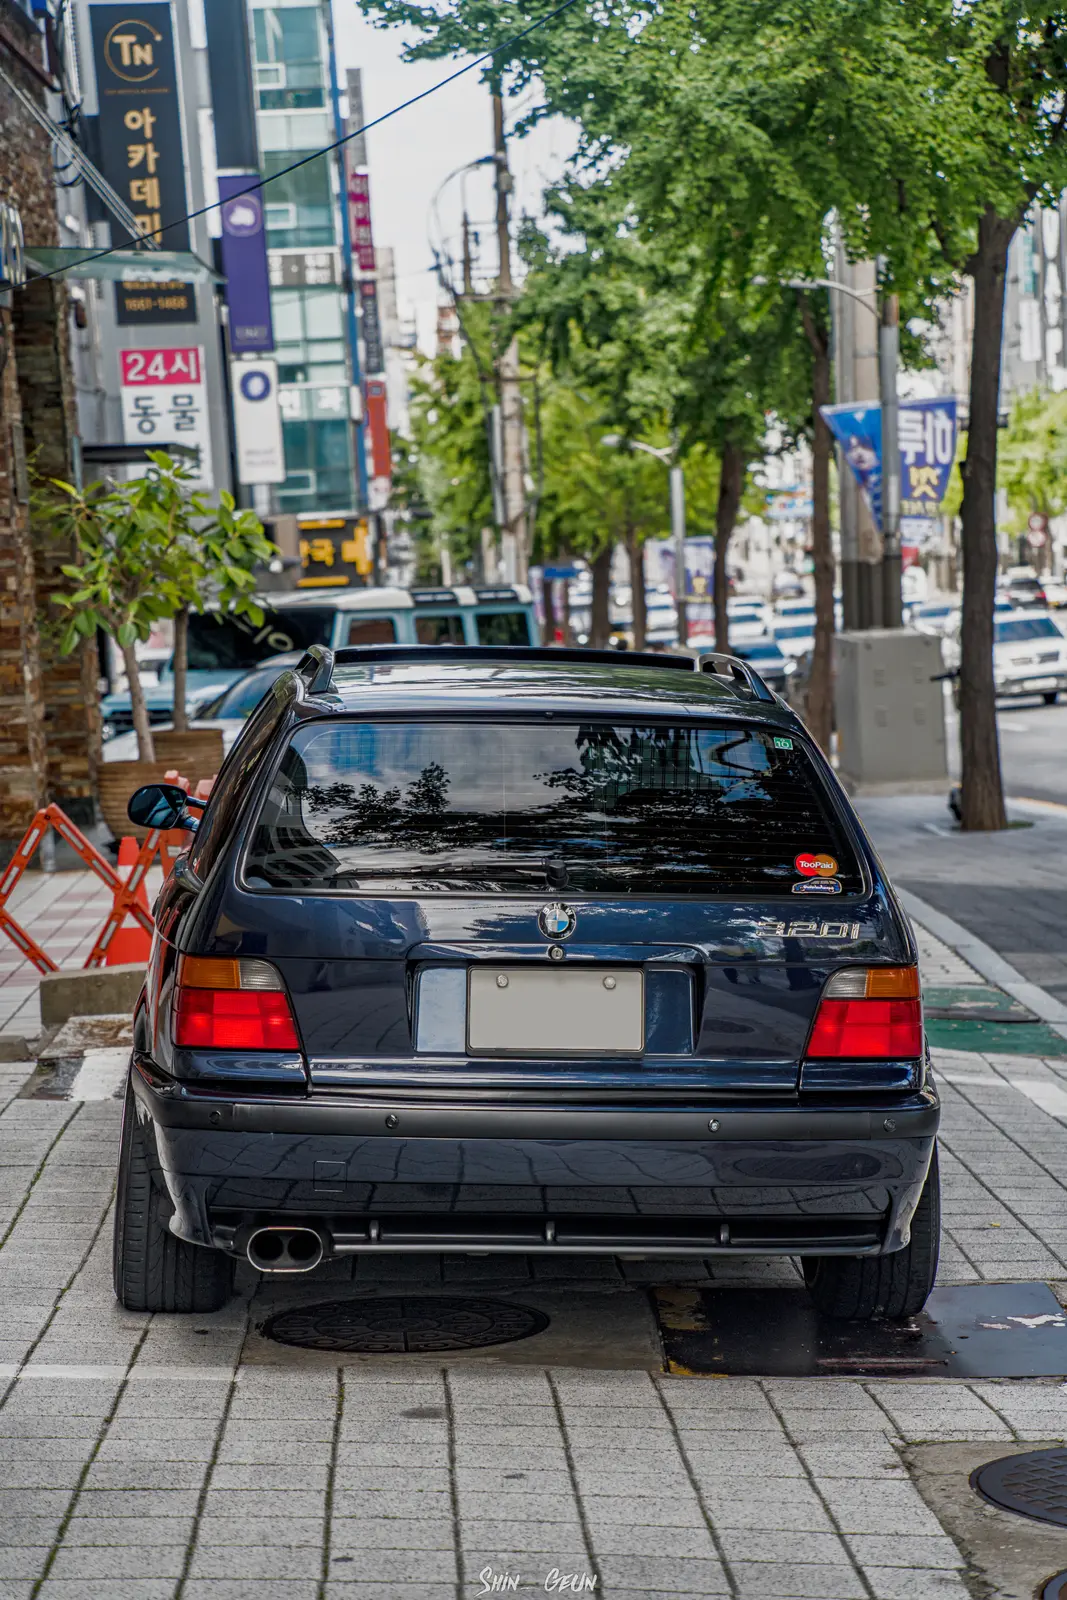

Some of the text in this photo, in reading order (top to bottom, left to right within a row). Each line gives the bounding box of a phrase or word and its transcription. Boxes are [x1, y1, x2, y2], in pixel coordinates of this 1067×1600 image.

[112, 34, 153, 66] TN
[124, 107, 162, 249] 아카데미
[126, 350, 198, 381] 24시
[799, 860, 834, 869] TooPaid
